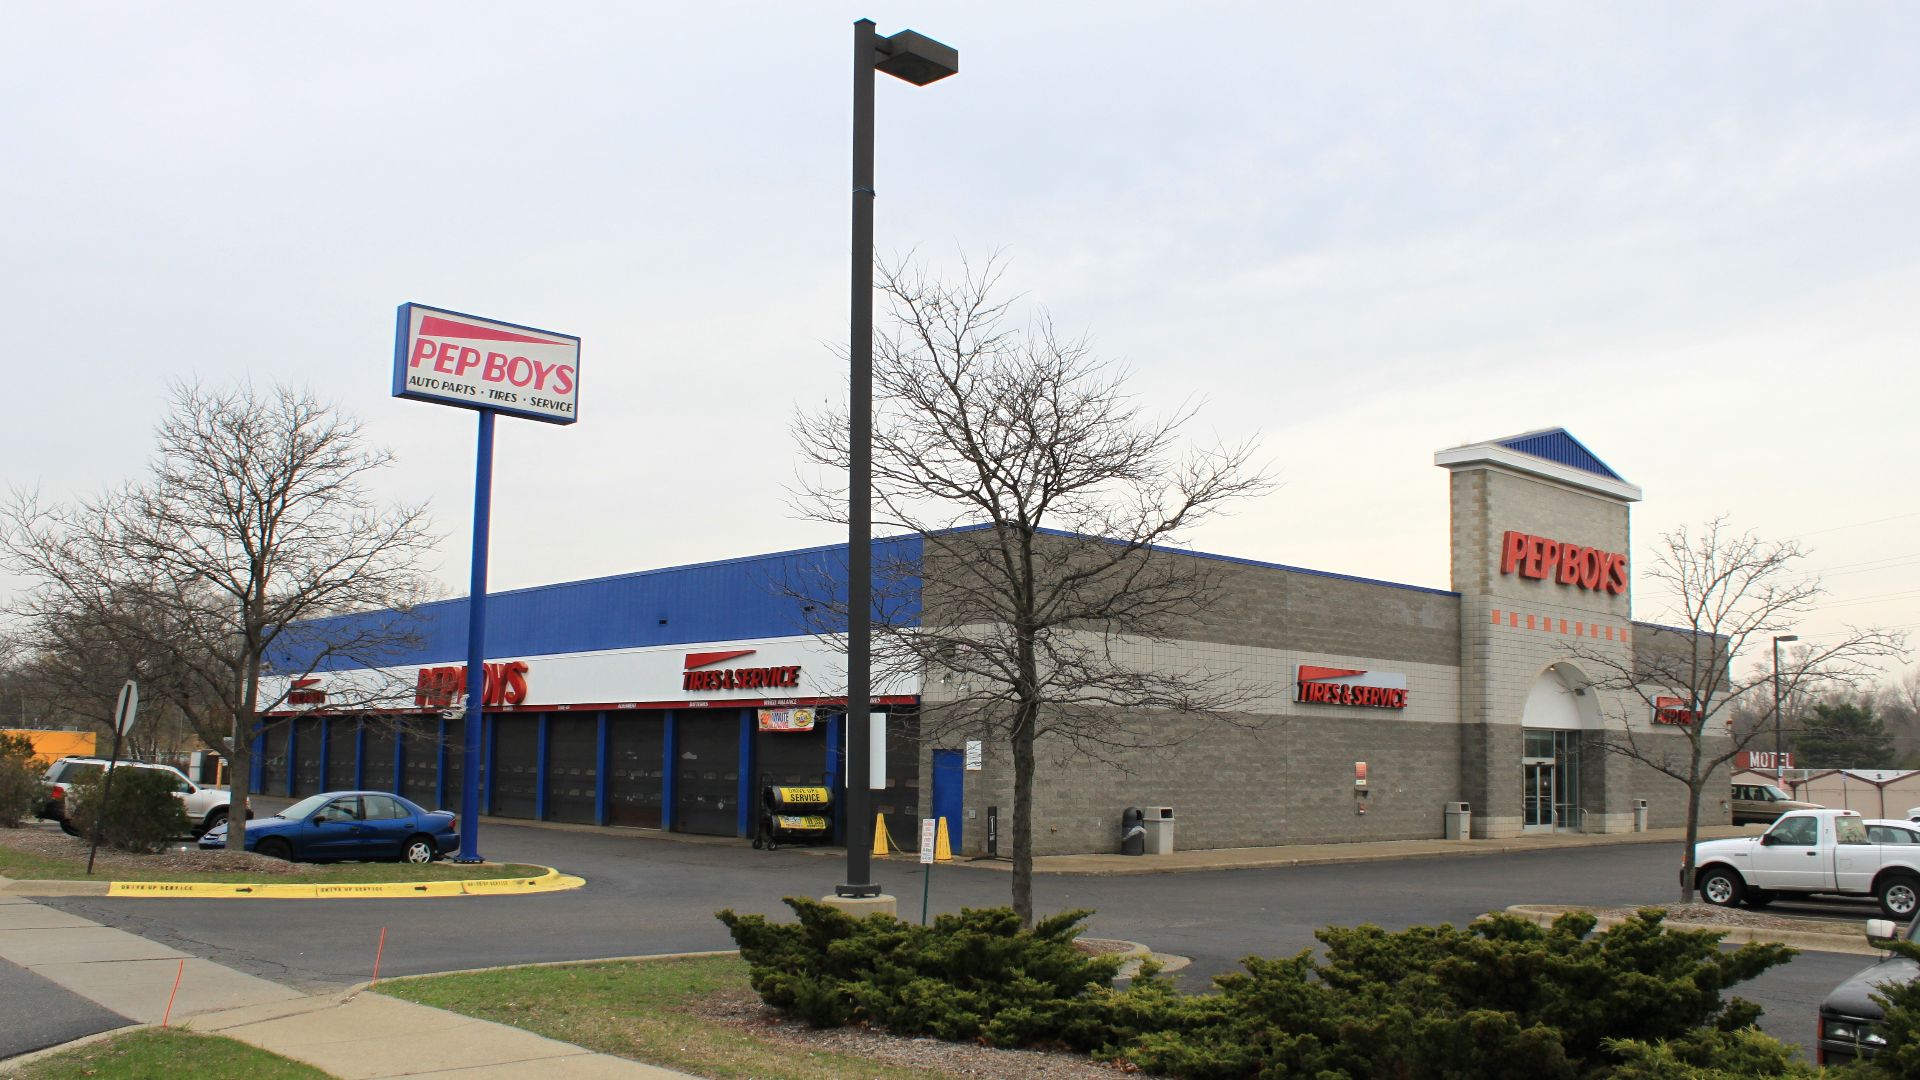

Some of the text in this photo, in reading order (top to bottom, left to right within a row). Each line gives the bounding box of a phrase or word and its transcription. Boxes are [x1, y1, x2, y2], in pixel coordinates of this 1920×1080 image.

[410, 338, 575, 395] PEP BOYS
[408, 375, 573, 413] AUTO PARTS TIRES SERVICE
[1500, 530, 1628, 594] PEP BOYS
[457, 661, 529, 705] YS
[1749, 751, 1794, 769] MOTEL
[790, 793, 820, 802] SERVICE
